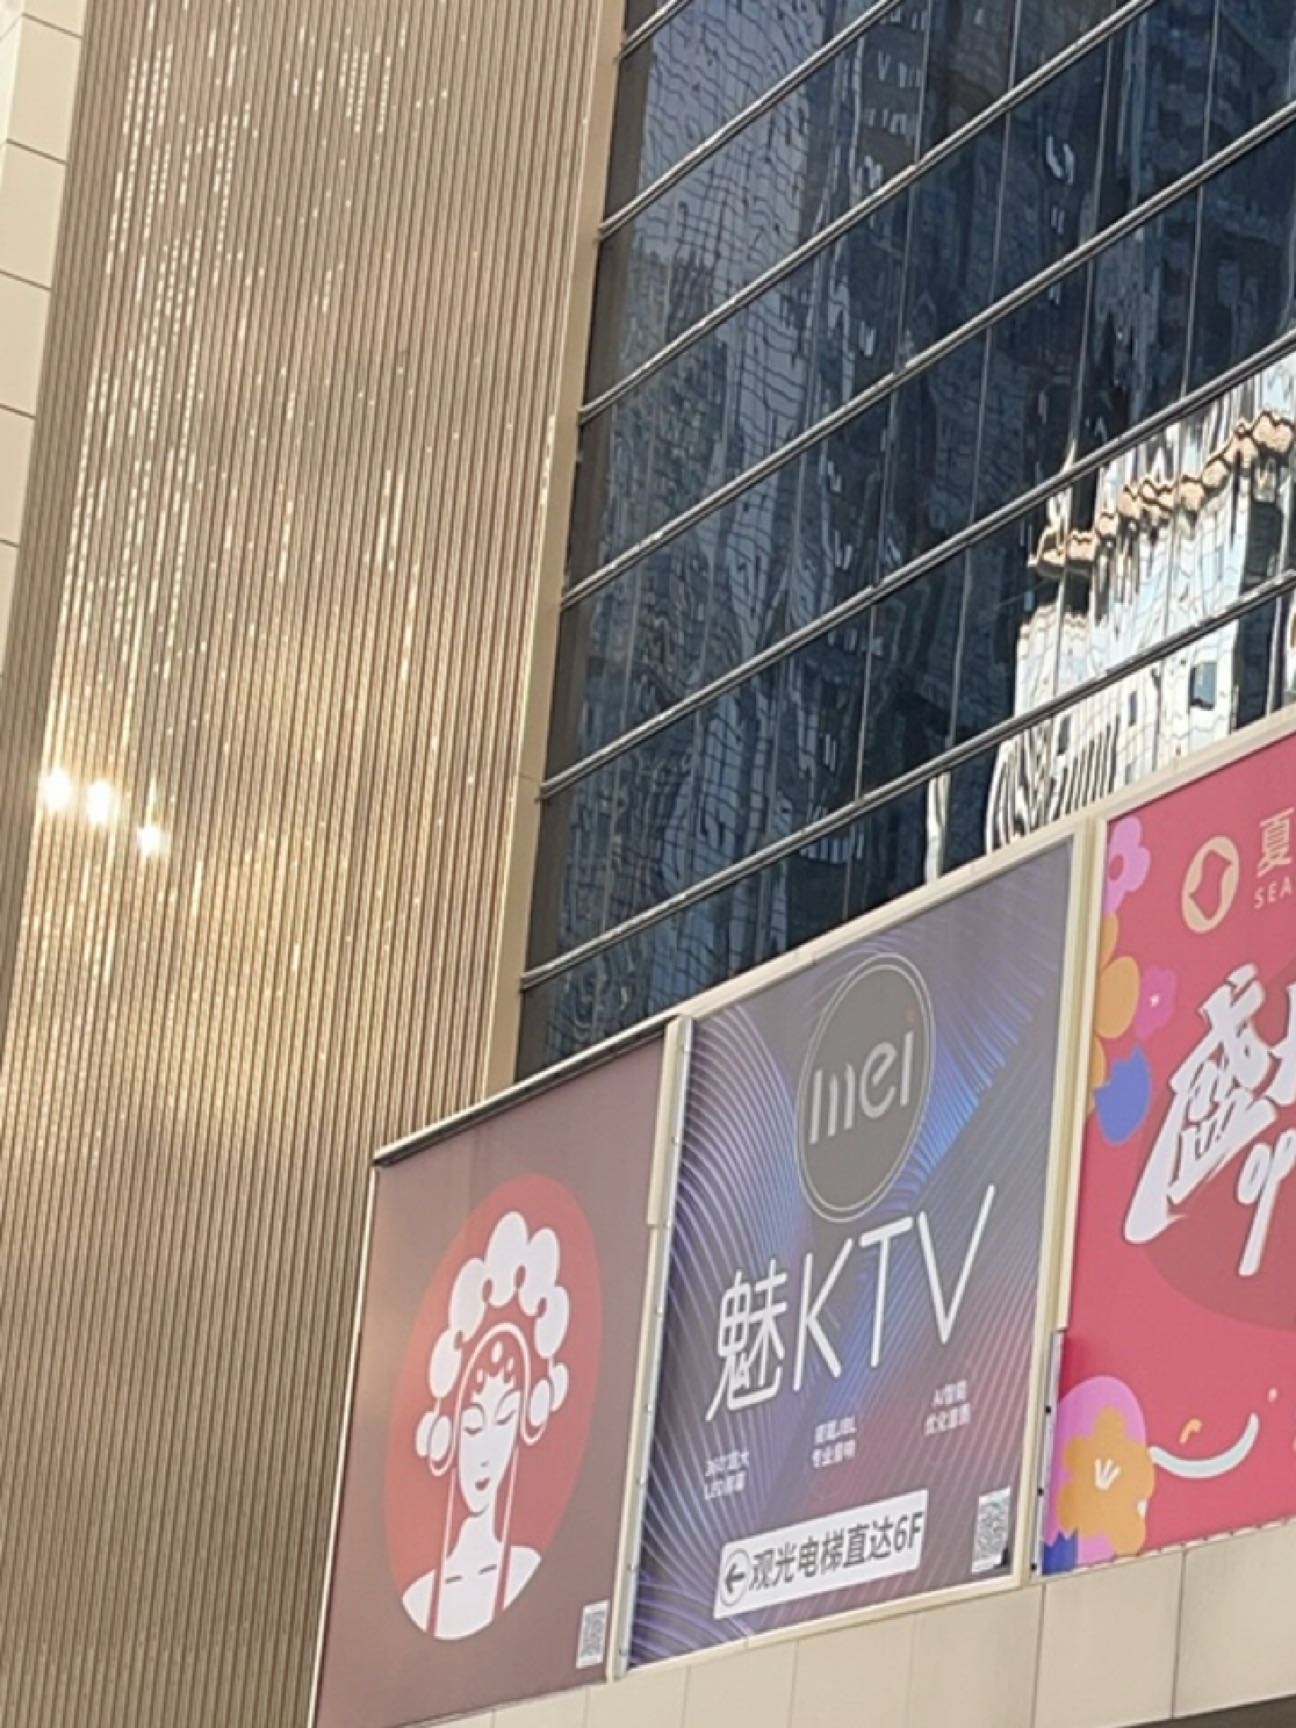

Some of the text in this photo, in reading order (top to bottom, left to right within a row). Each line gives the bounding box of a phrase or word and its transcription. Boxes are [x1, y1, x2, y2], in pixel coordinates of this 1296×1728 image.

[706, 1184, 995, 1421] 魅KTV
[748, 1511, 924, 1591] 观光电梯直达6F
